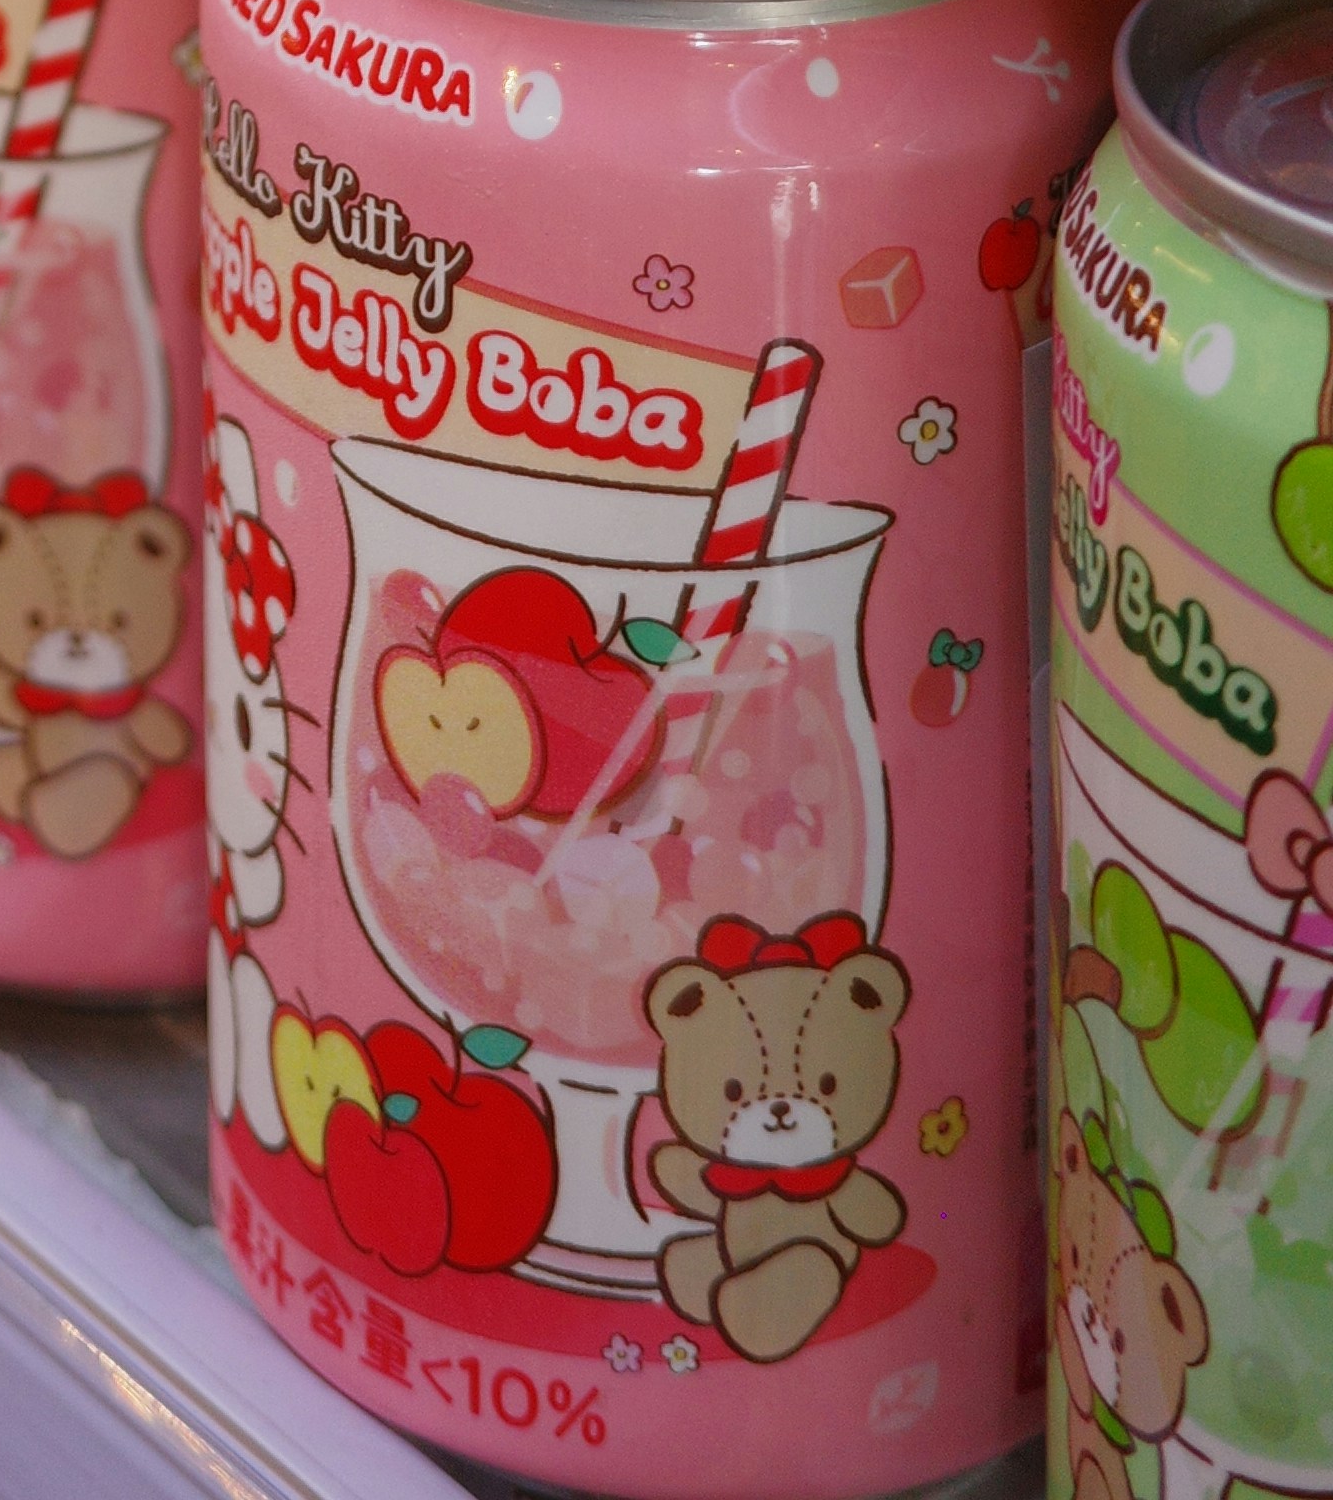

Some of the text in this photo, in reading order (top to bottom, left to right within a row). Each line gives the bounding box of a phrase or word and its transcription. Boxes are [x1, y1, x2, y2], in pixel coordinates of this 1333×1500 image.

[203, 216, 703, 471] pple Jelly Boba
[291, 142, 473, 333] Kitty
[1064, 188, 1167, 353] SAKURA
[1055, 472, 1278, 756] elly Boba
